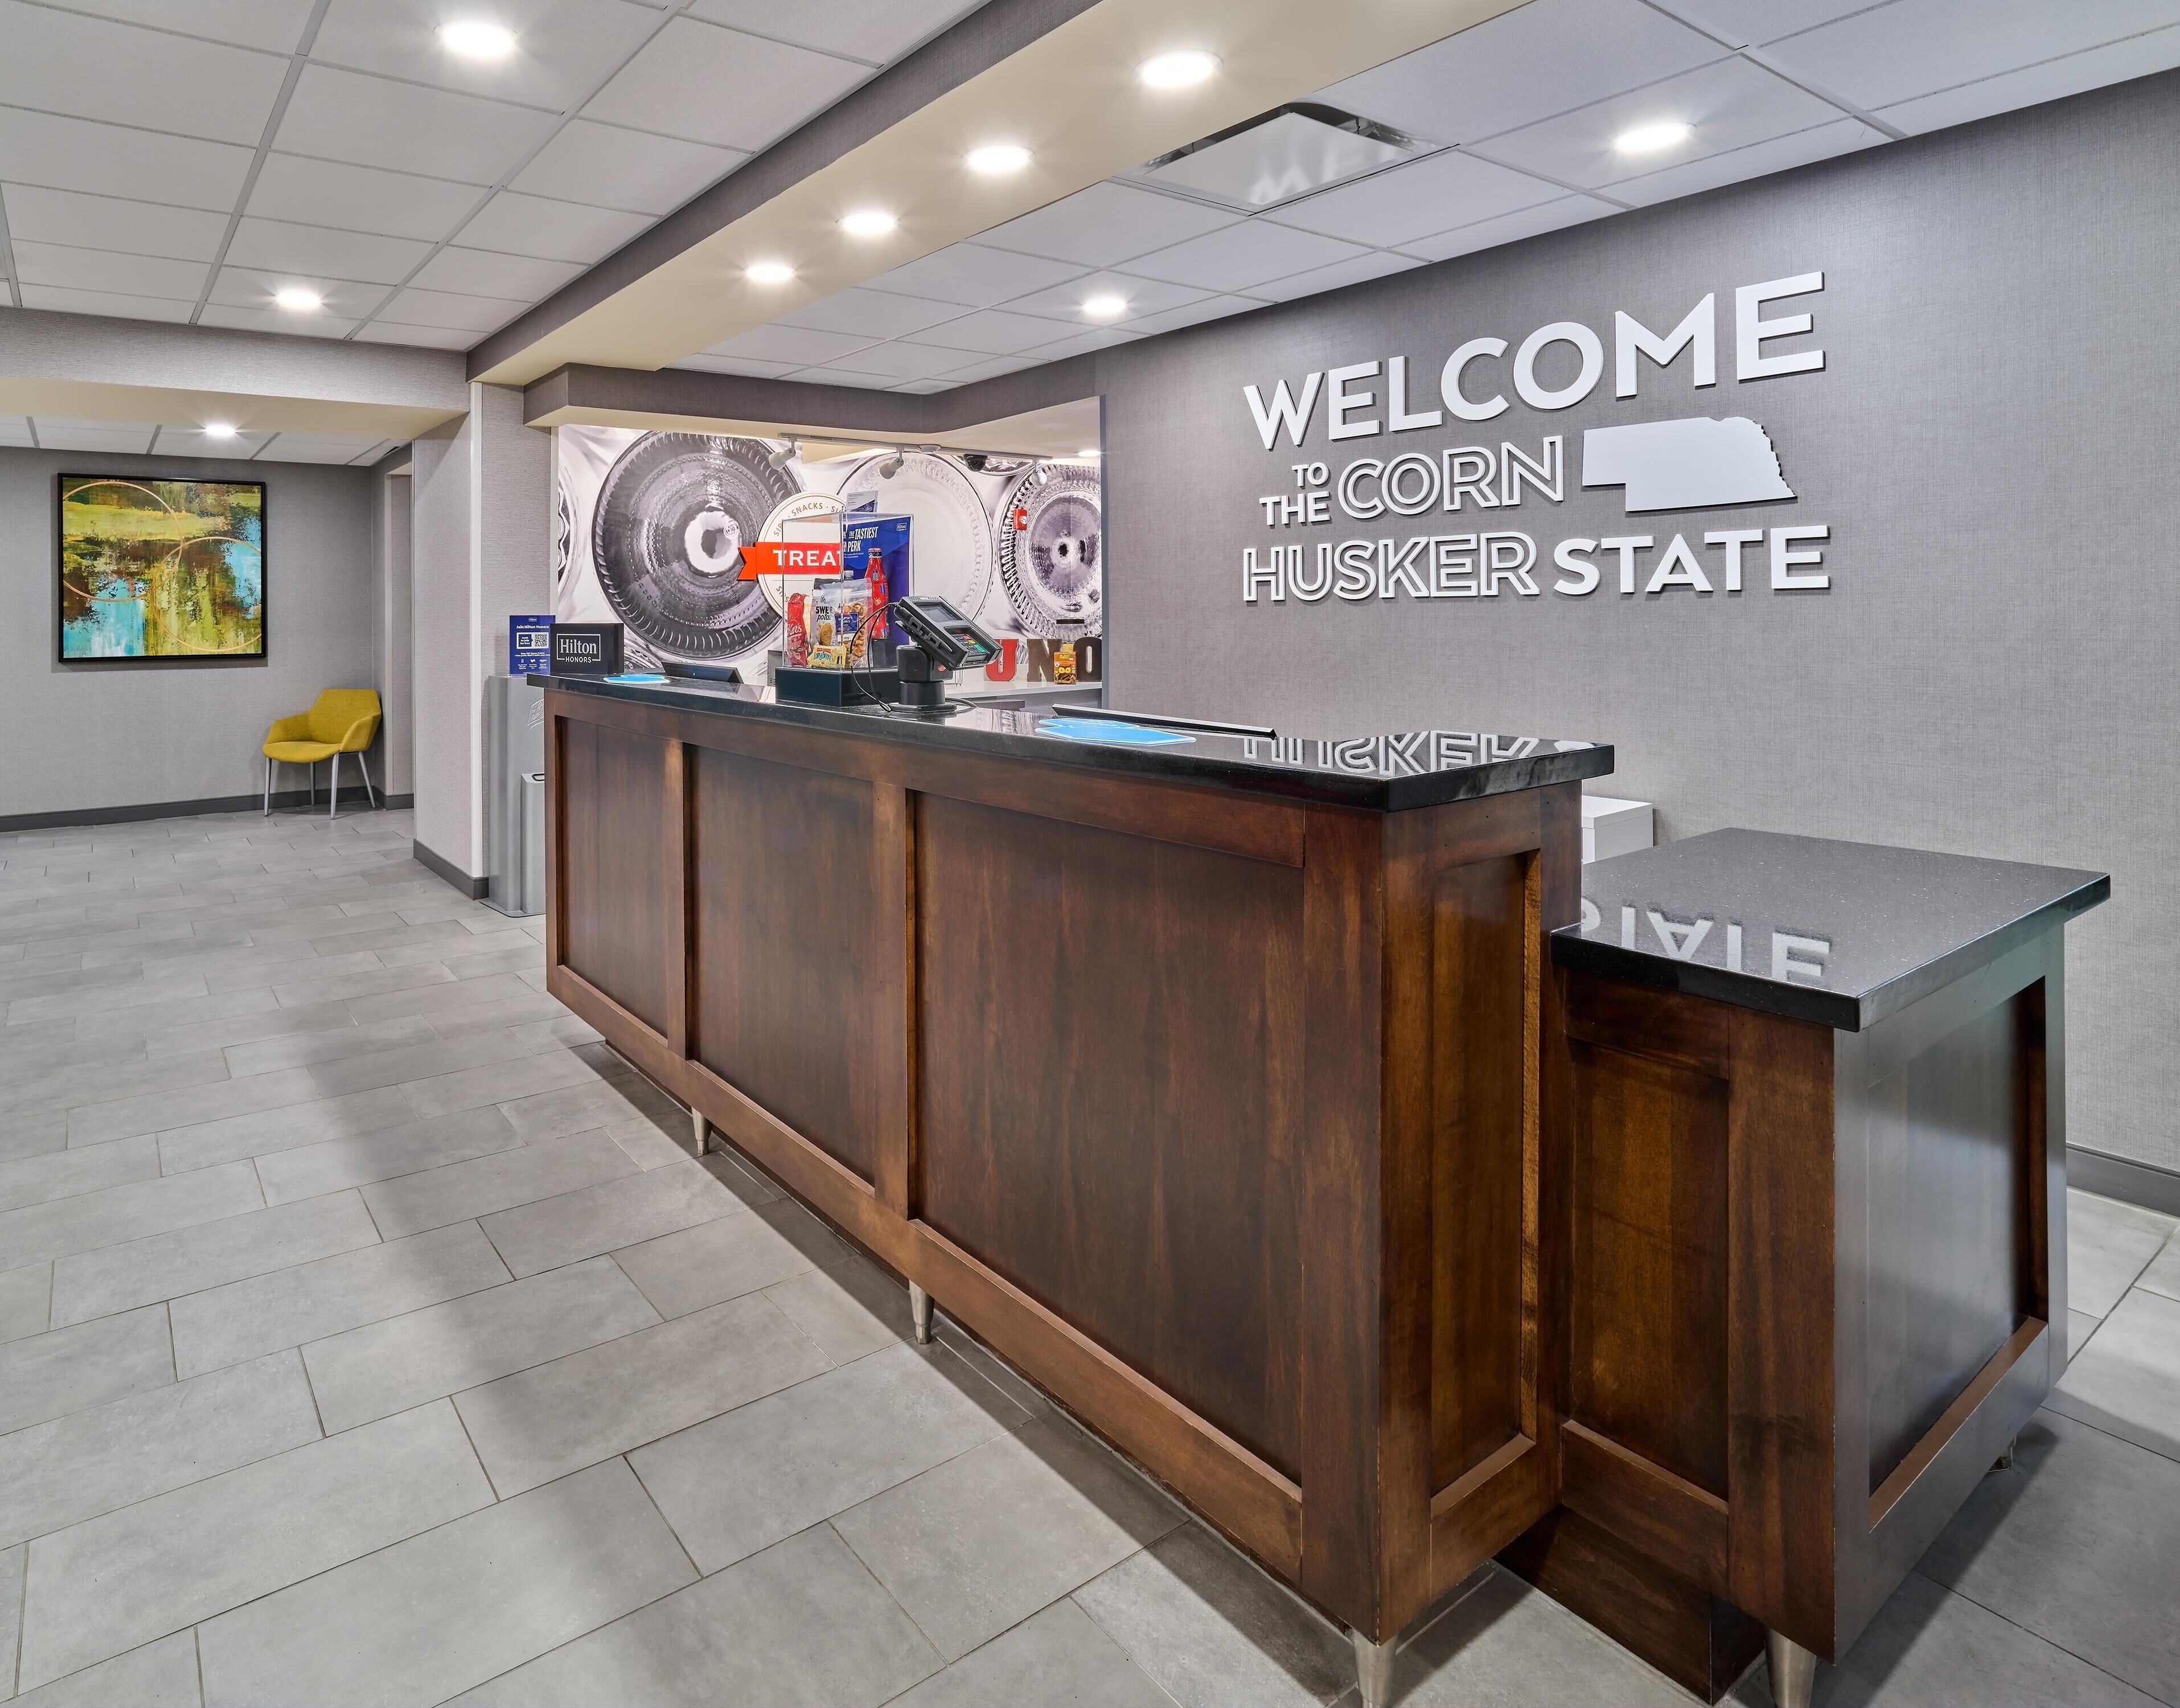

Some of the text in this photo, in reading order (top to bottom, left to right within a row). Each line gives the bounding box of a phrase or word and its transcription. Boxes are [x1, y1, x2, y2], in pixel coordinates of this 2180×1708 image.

[1243, 271, 1825, 450] WELCOME
[1259, 434, 1563, 525] THE CORN
[1291, 462, 1330, 488] TO
[791, 503, 823, 516] SNACKS
[855, 527, 878, 540] TASTIEST
[847, 540, 861, 552] PERK
[1242, 524, 1830, 602] HUSKER STATE
[560, 639, 597, 654] Hilton
